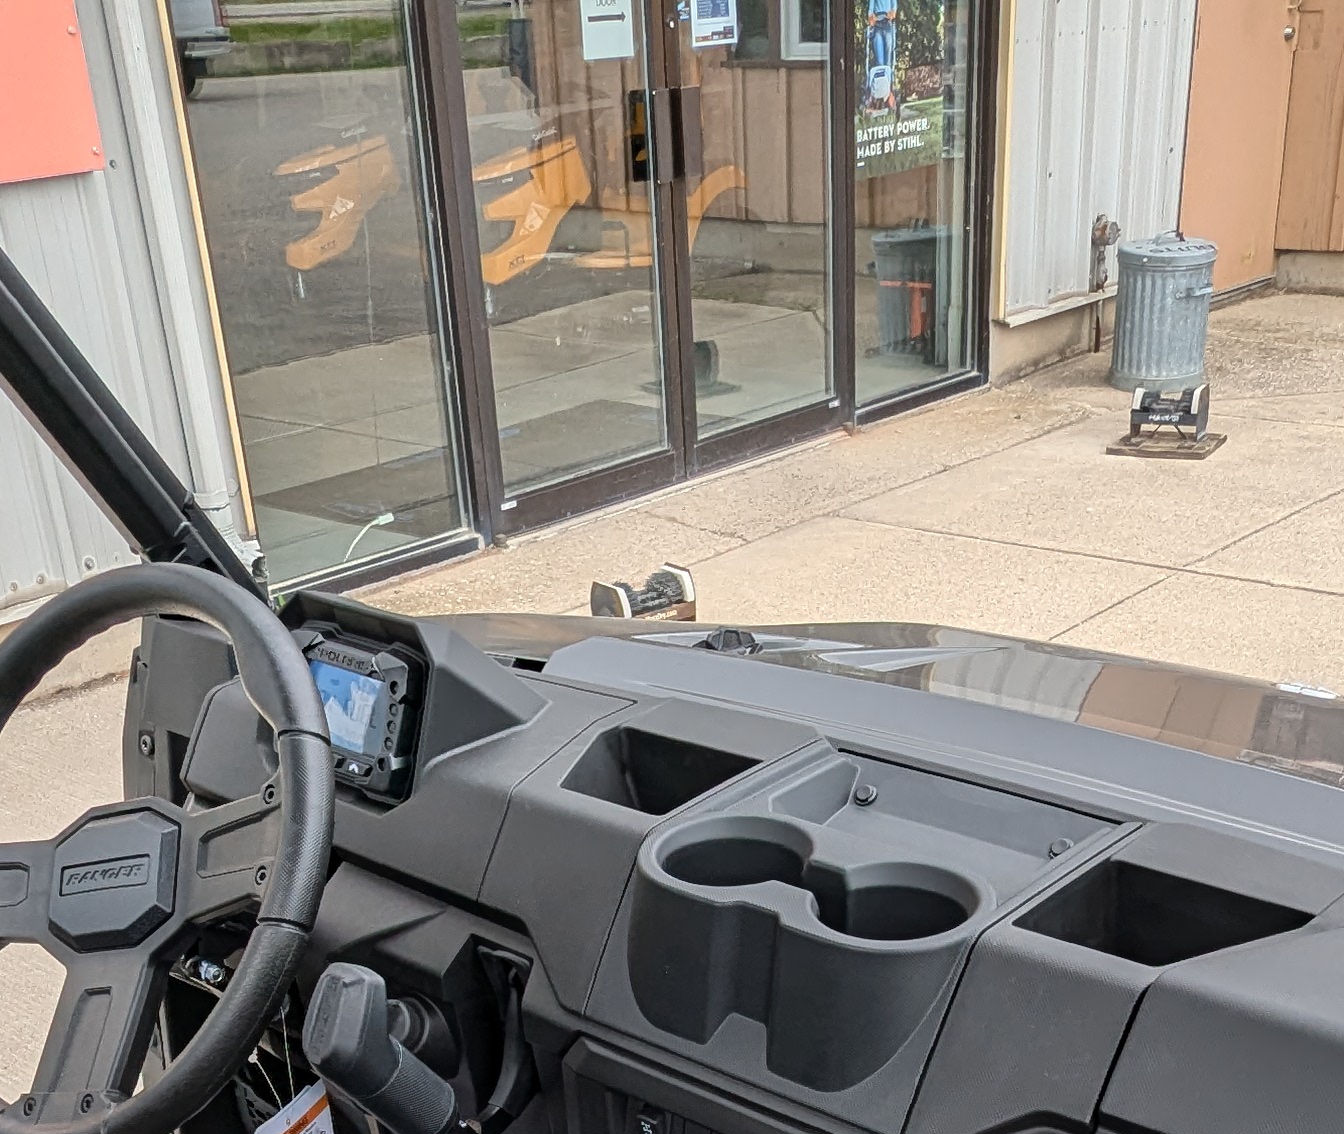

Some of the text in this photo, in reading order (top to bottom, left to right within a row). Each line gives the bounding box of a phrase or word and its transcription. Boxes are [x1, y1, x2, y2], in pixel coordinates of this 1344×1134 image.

[856, 118, 931, 143] BATTERY POWER.
[856, 135, 925, 160] MADE BY STIHL.
[65, 862, 146, 886] RANGER
